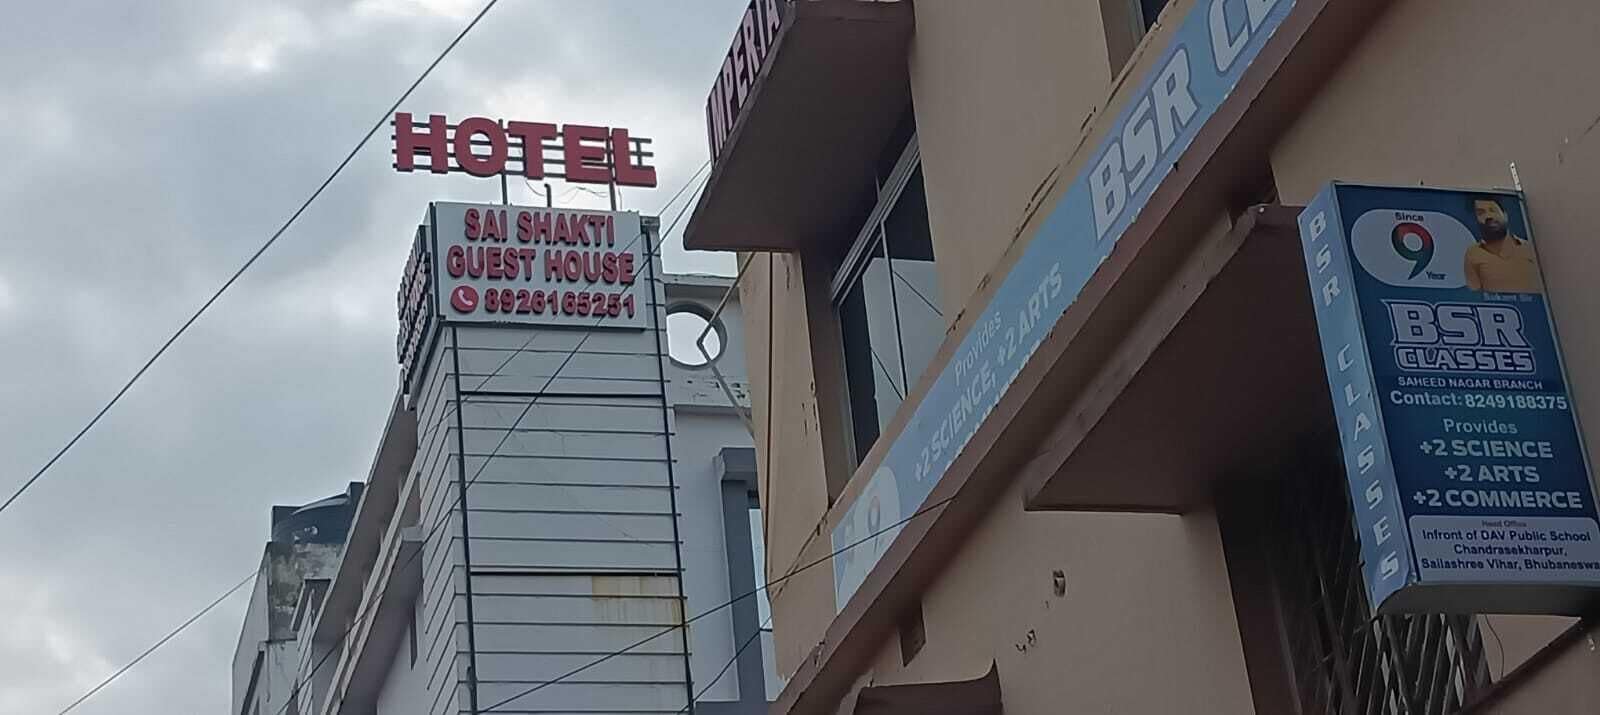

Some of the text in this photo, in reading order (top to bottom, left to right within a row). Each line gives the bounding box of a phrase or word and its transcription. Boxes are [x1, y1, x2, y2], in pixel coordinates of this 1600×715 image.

[395, 112, 657, 188] HOTEL
[1088, 48, 1199, 241] BSR
[464, 208, 615, 247] SAI SHAKTI
[1394, 211, 1424, 222] Since
[446, 245, 635, 285] GUEST HOUSE
[1390, 222, 1435, 281] 9
[1426, 270, 1447, 281] Year
[484, 288, 636, 319] 8926165251
[1018, 262, 1063, 345] ARTS
[1385, 301, 1532, 347] BSR
[954, 311, 1002, 387] Provides
[1397, 349, 1534, 372] CLASSES
[1308, 211, 1400, 581] BSR CLASSES
[1398, 377, 1543, 390] SAHEED NAGAR BRANCH
[1443, 418, 1519, 434] Provides
[1420, 439, 1553, 458] +2 SCIENCE
[1444, 465, 1540, 483] +2 ARTS
[1413, 489, 1583, 509] +2 COMMERCE
[1422, 529, 1591, 542] Infront of DAV Public School
[1487, 559, 1522, 571] Vihar,
